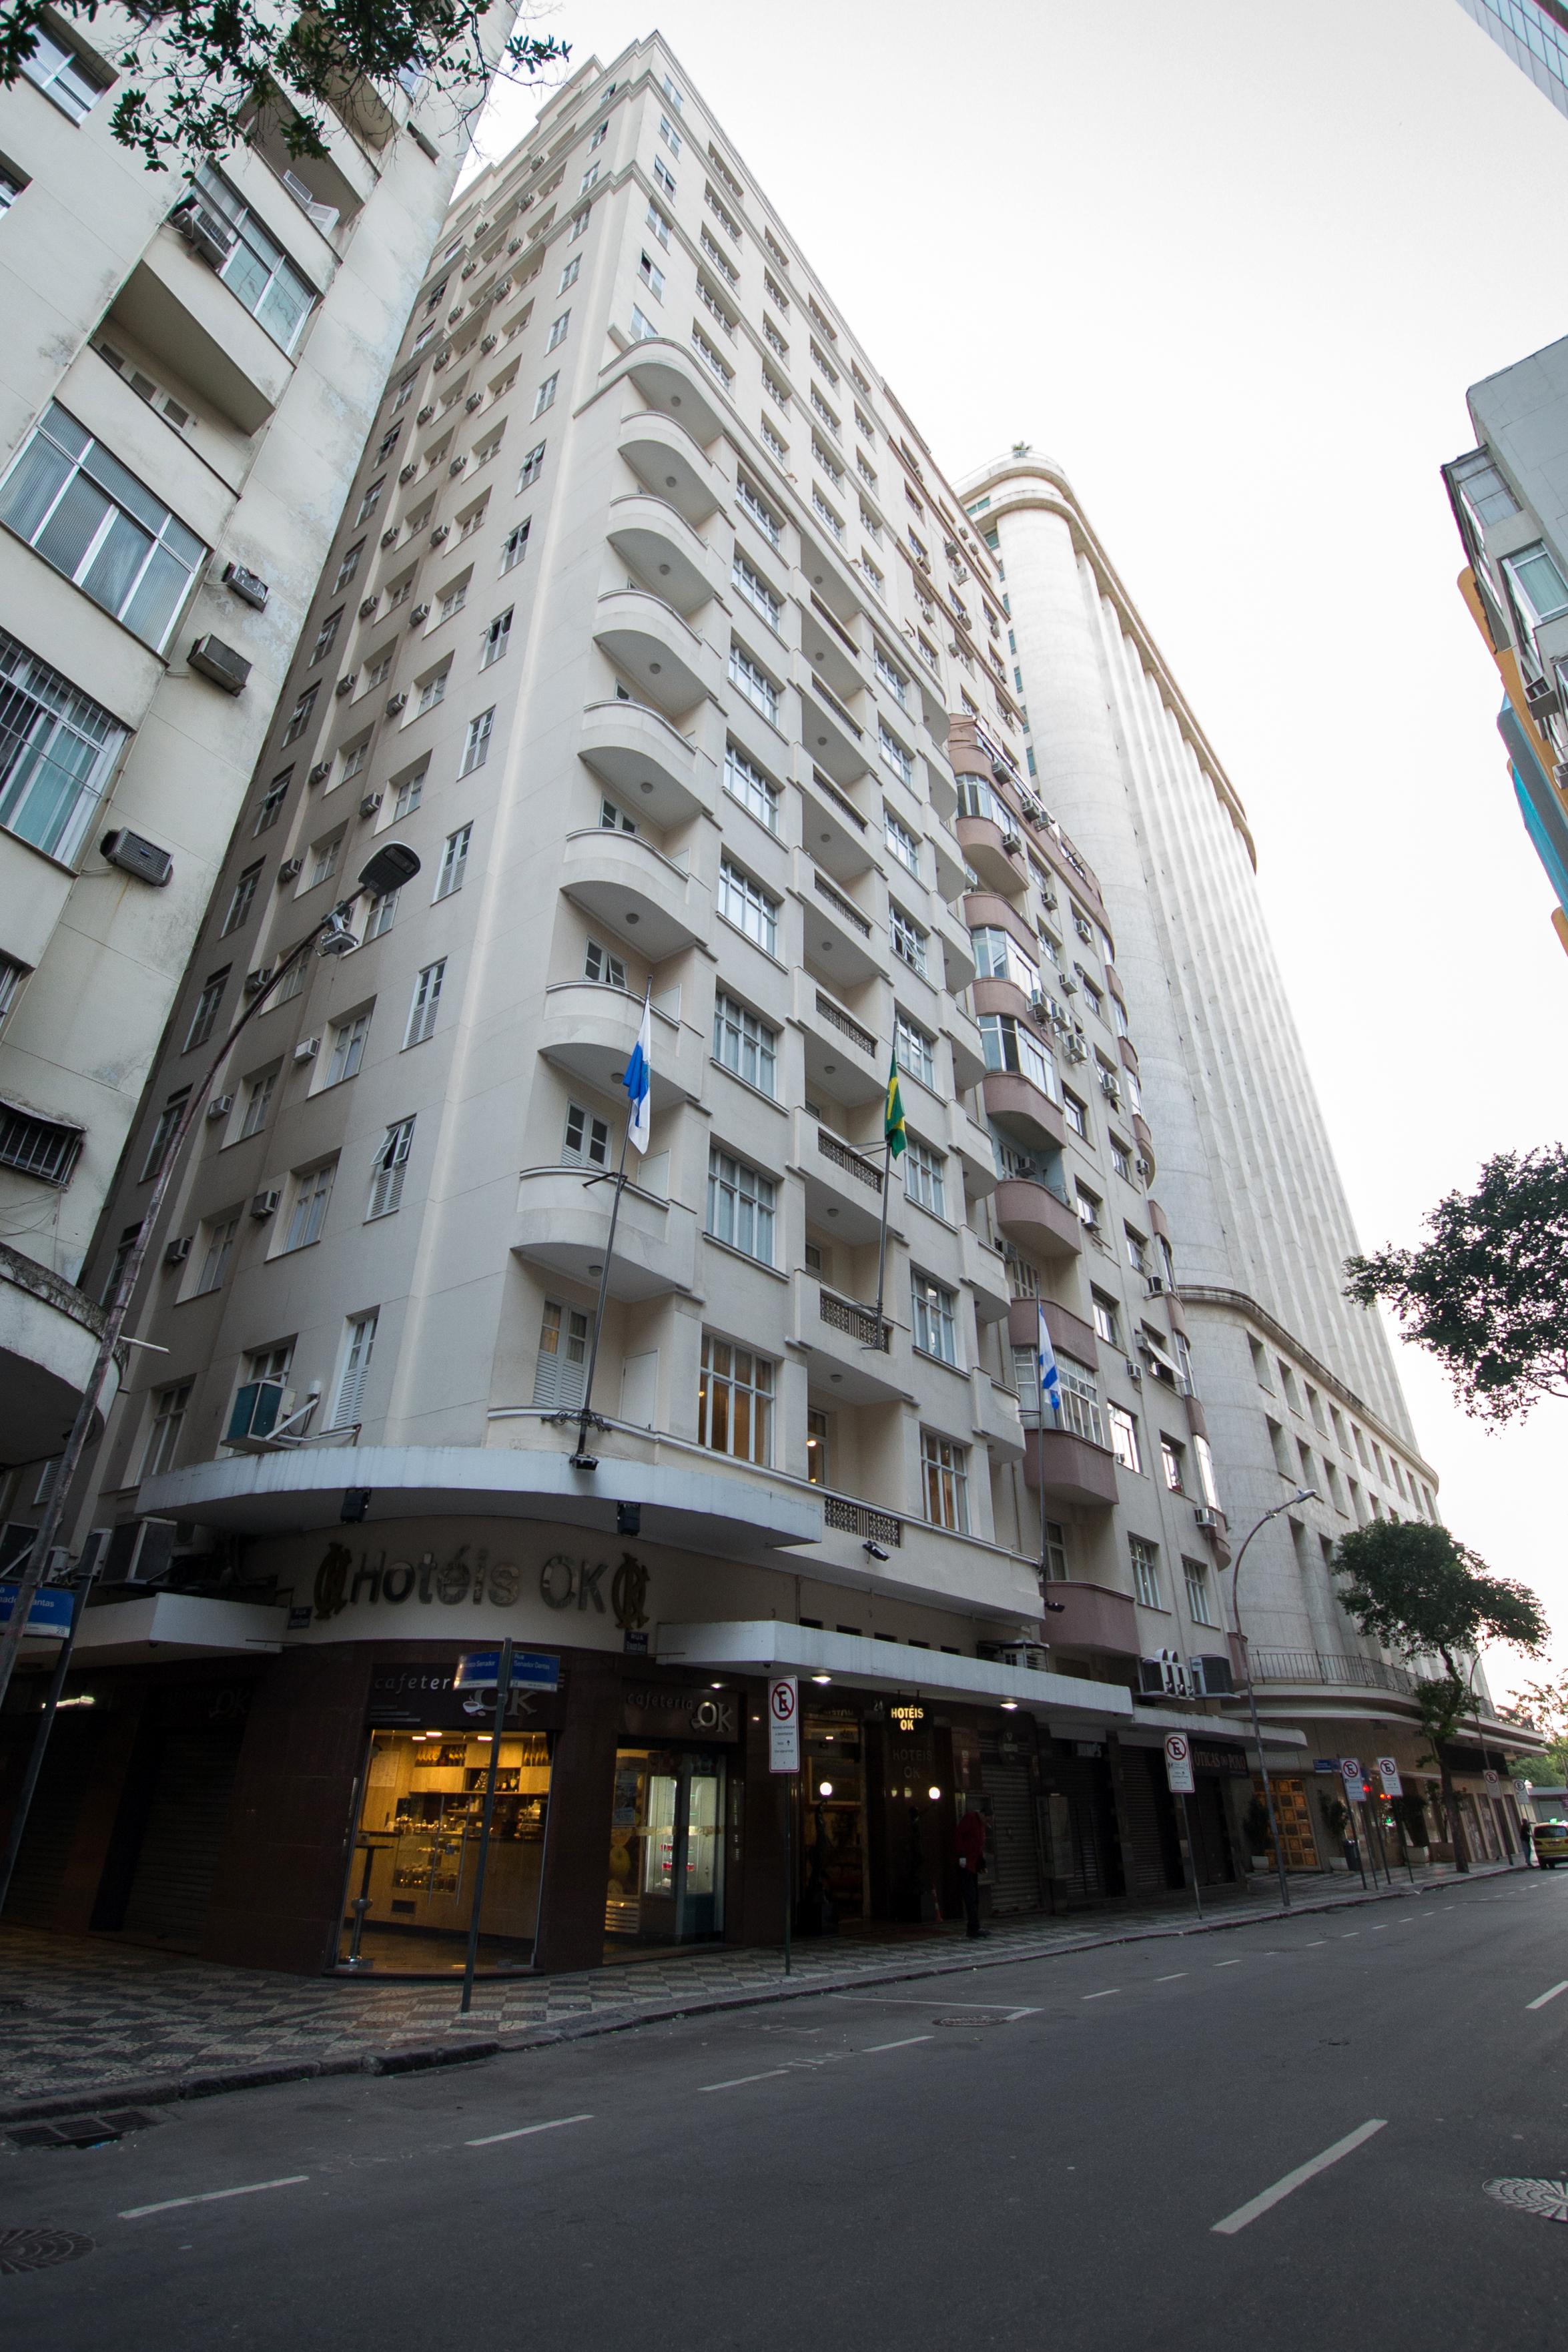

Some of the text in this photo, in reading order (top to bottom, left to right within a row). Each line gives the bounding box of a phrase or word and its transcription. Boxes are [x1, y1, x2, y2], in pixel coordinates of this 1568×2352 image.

[352, 1545, 609, 1613] Hotéis OK
[31, 1599, 54, 1607] antas
[374, 1672, 452, 1695] cafeter
[627, 1691, 734, 1733] cafeteria OK
[873, 1700, 884, 1712] 24
[891, 1704, 925, 1719] HOTÉIS
[900, 1719, 915, 1731] OK
